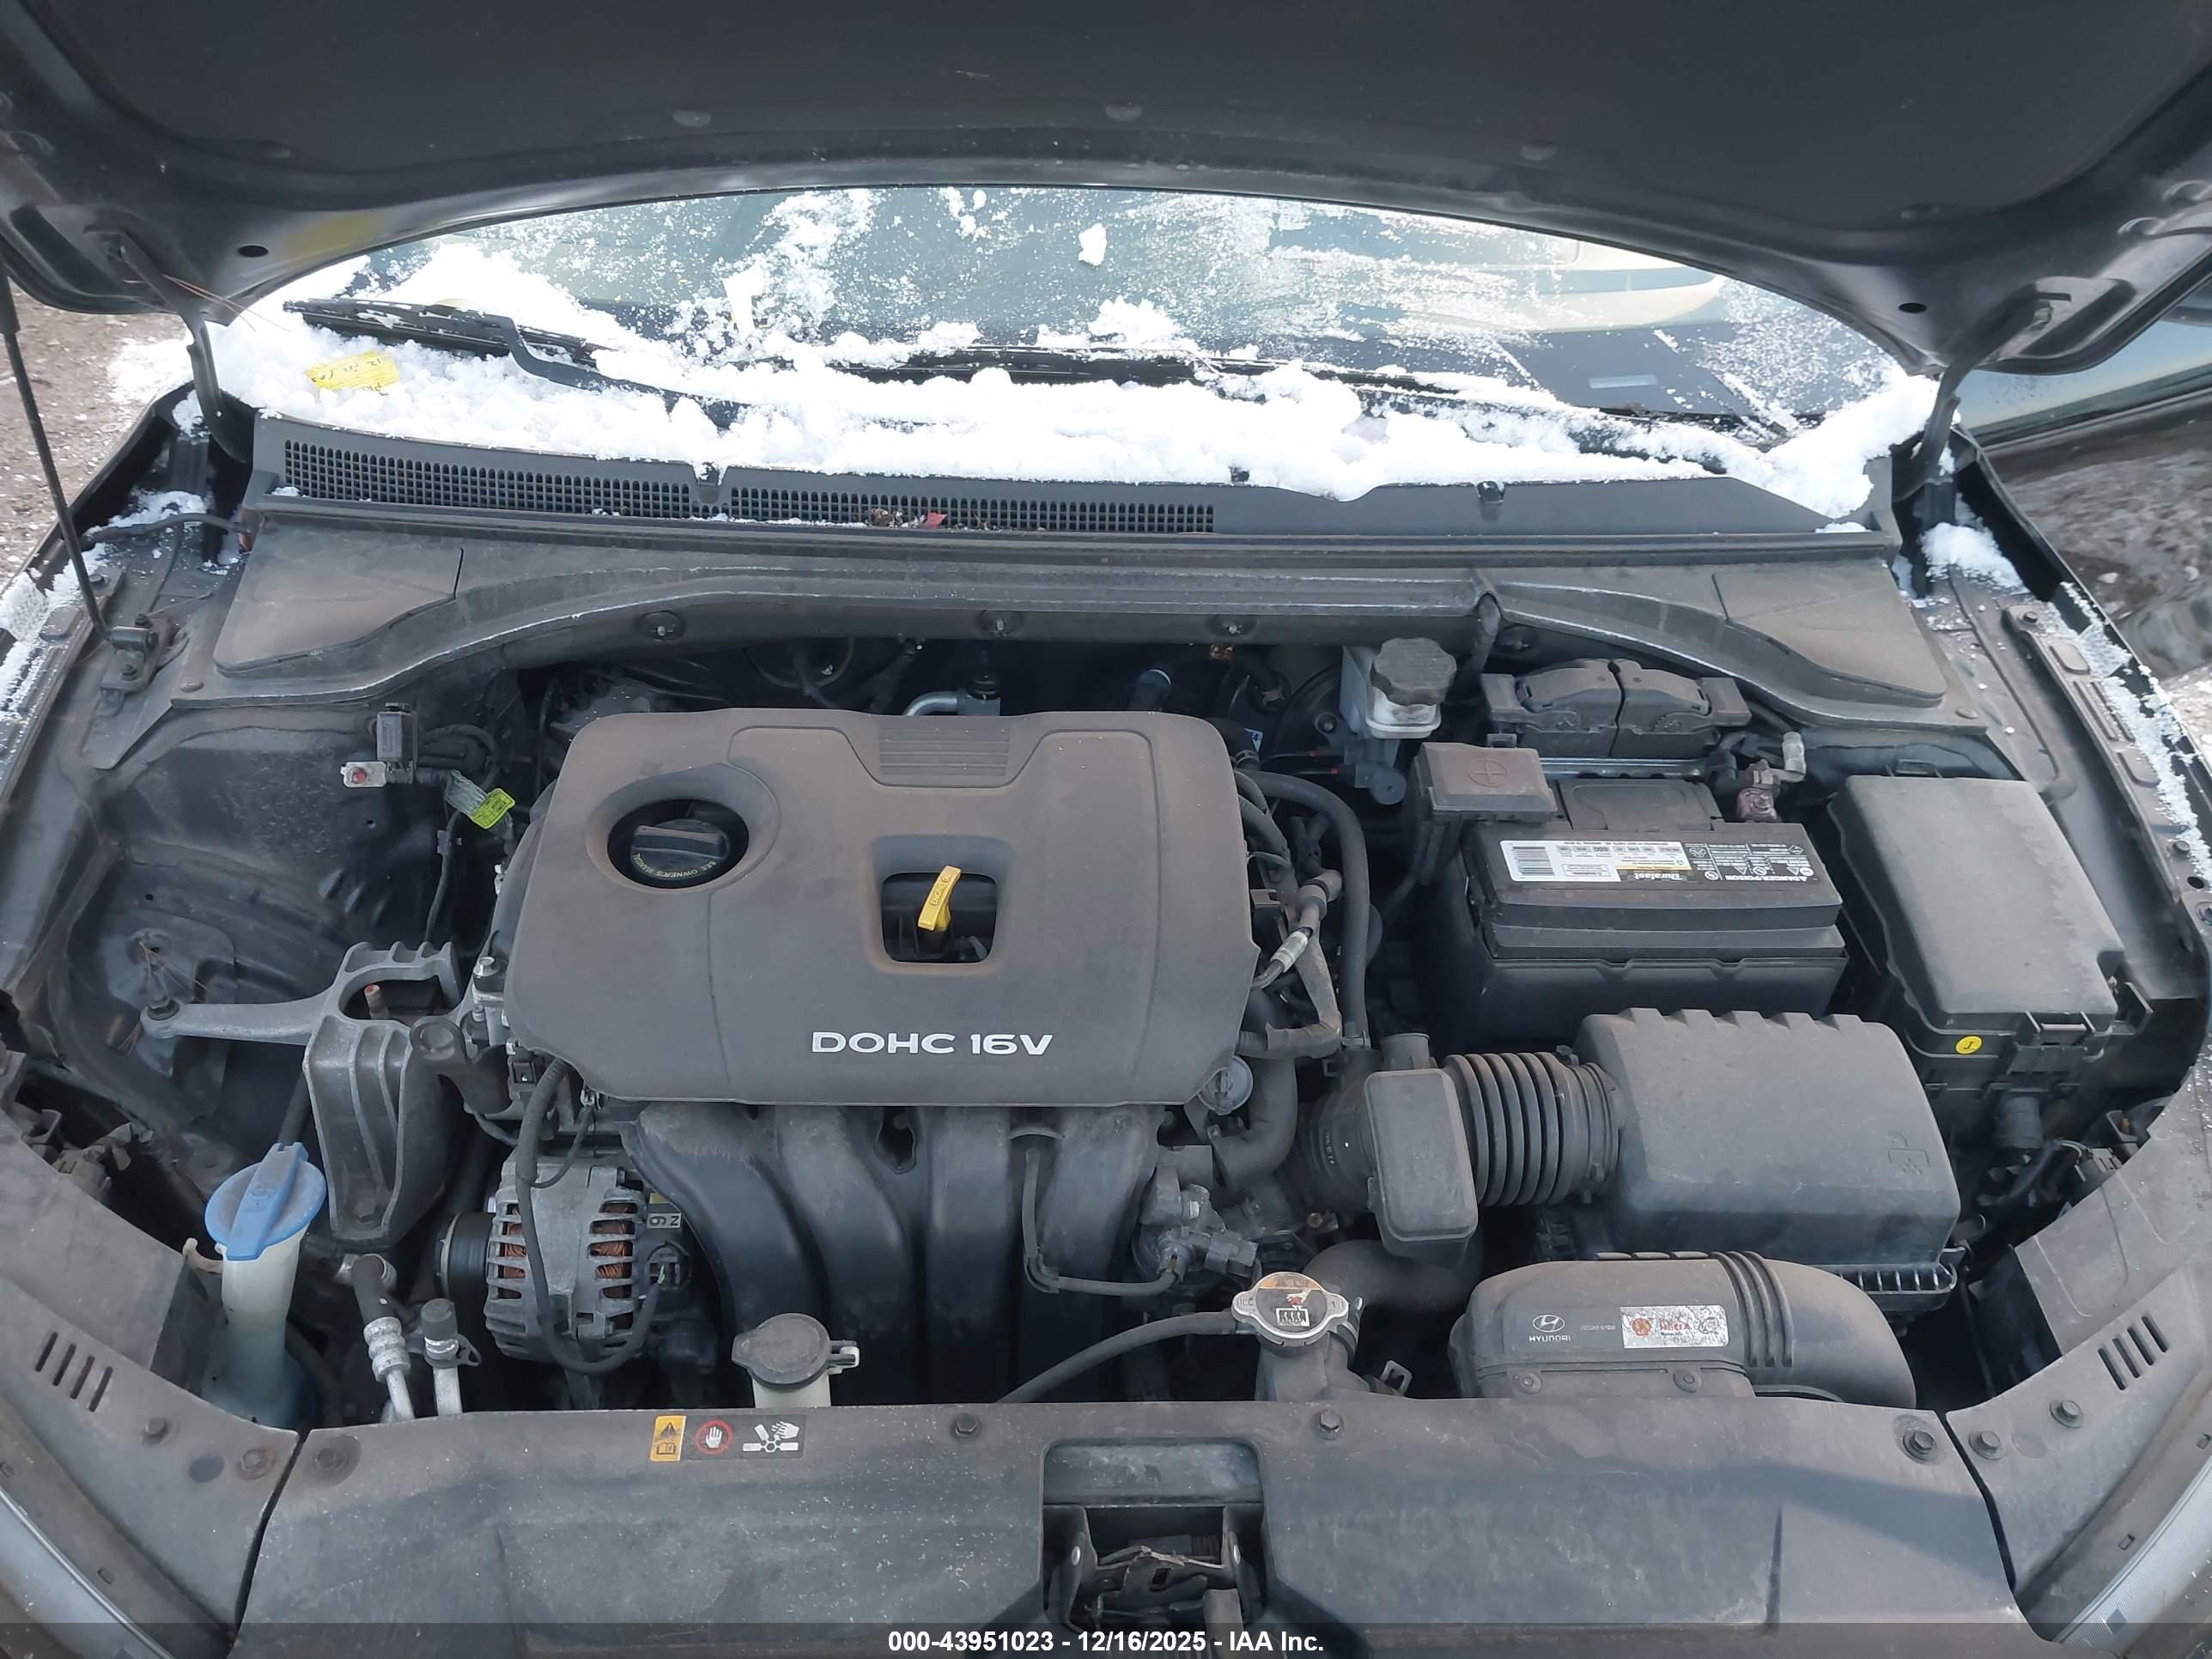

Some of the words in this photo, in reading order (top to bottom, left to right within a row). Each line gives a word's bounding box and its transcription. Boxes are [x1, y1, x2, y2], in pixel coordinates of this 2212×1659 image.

[699, 860, 717, 872] SEE
[1634, 872, 1684, 880] Duralast
[811, 1030, 956, 1054] DOHC
[969, 1033, 1054, 1055] 16V
[1963, 1041, 1974, 1050] J
